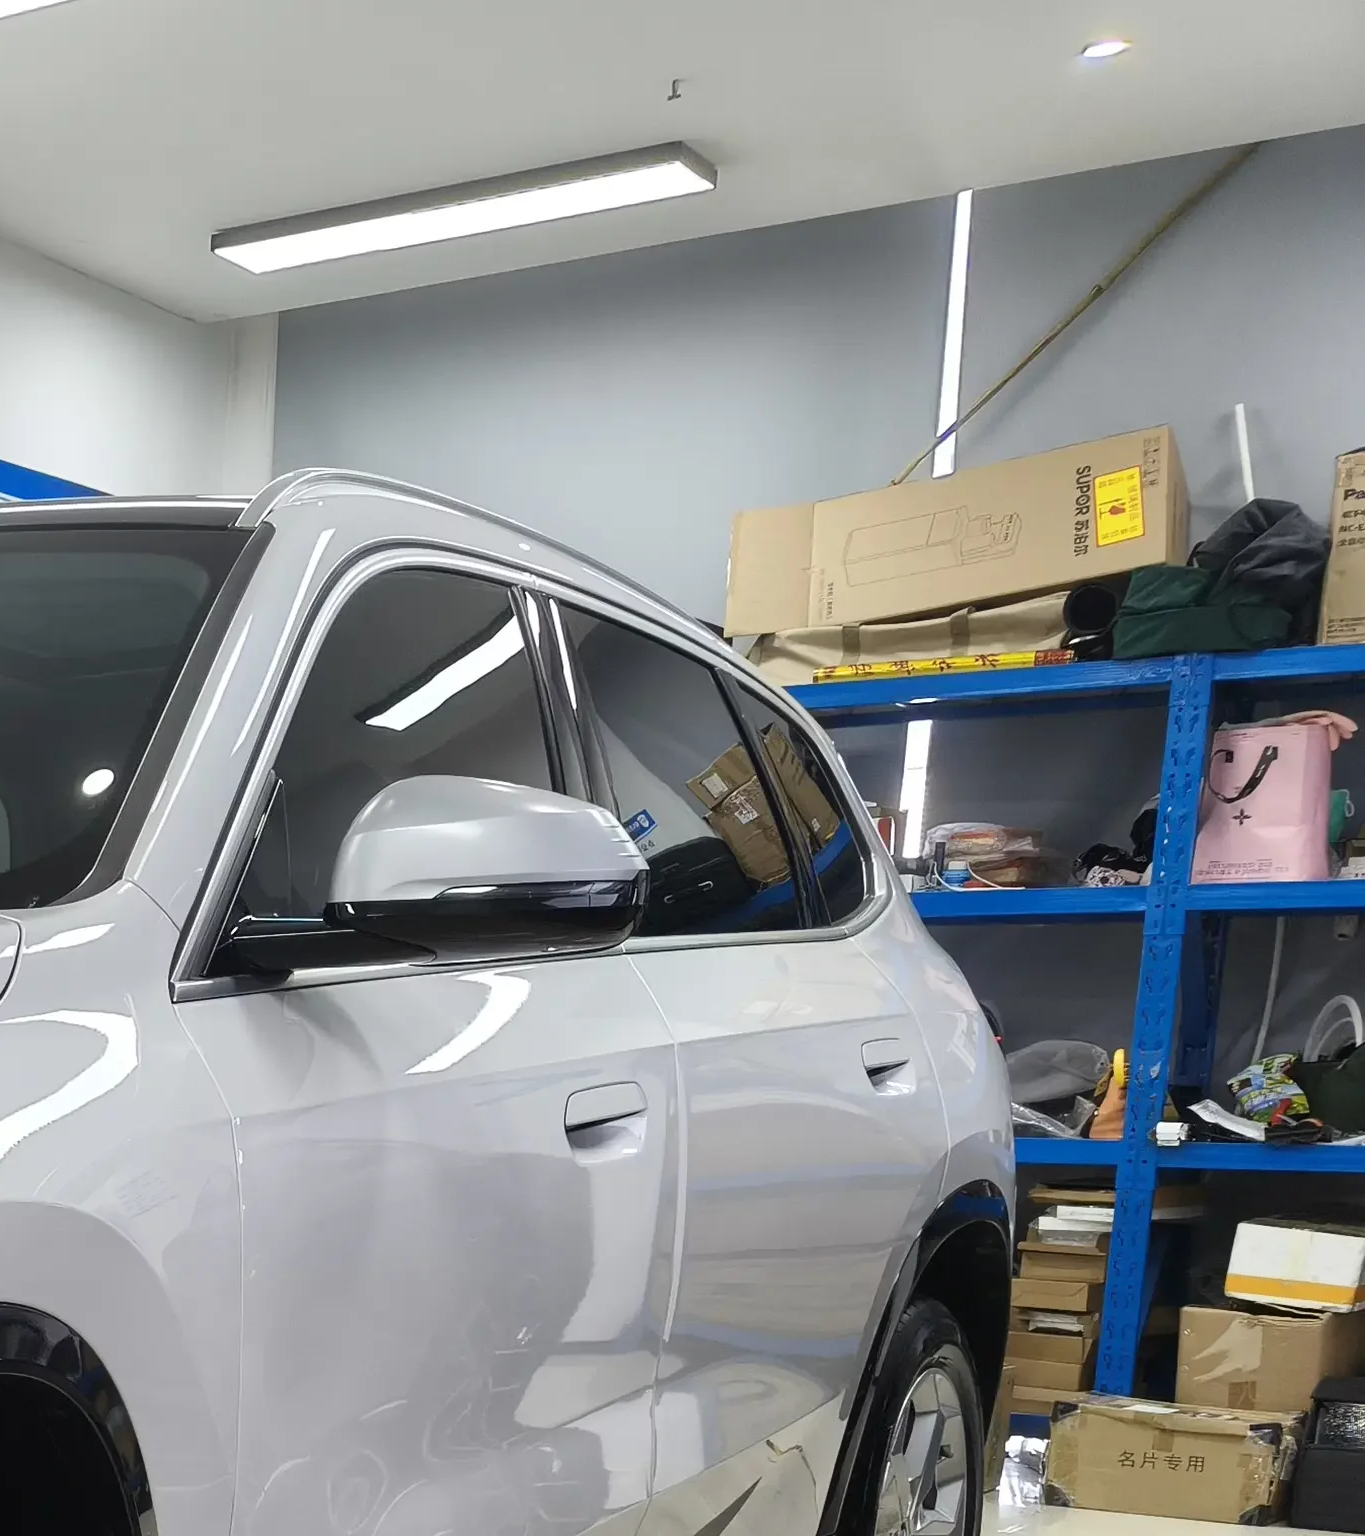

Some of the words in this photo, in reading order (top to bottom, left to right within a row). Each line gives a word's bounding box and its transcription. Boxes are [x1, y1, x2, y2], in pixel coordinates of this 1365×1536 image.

[1075, 465, 1091, 517] SUPOR
[1073, 519, 1089, 557] 苏泊尔
[1117, 1450, 1205, 1473] 名片专用
